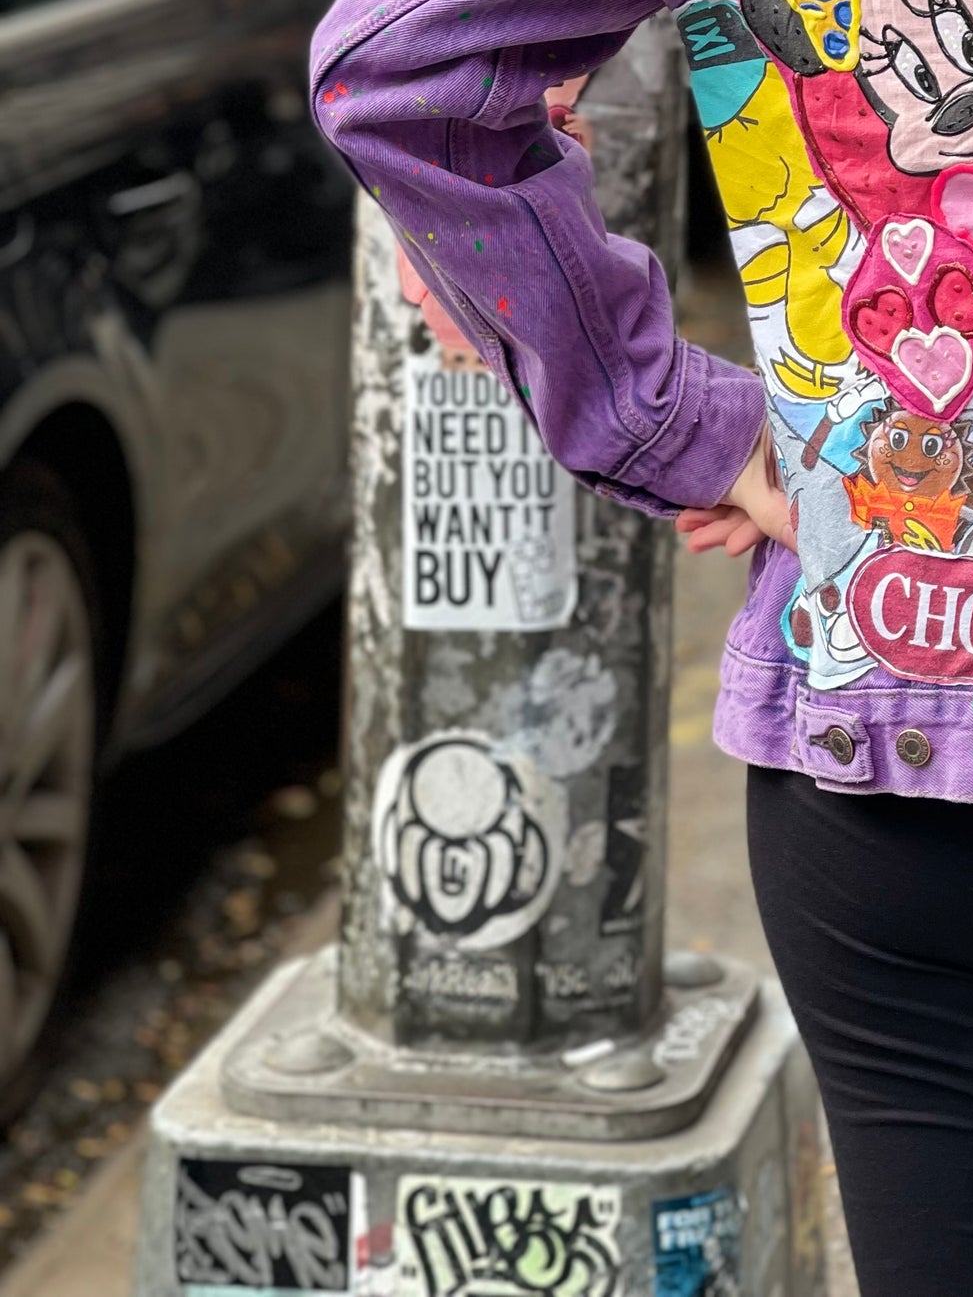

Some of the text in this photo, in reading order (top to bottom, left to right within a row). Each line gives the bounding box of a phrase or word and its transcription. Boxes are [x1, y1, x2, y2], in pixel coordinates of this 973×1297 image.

[413, 373, 468, 406] YOU
[413, 411, 506, 454] NEED
[414, 459, 555, 500] BUT YOU
[412, 504, 515, 544] WANT
[414, 550, 503, 608] BUY
